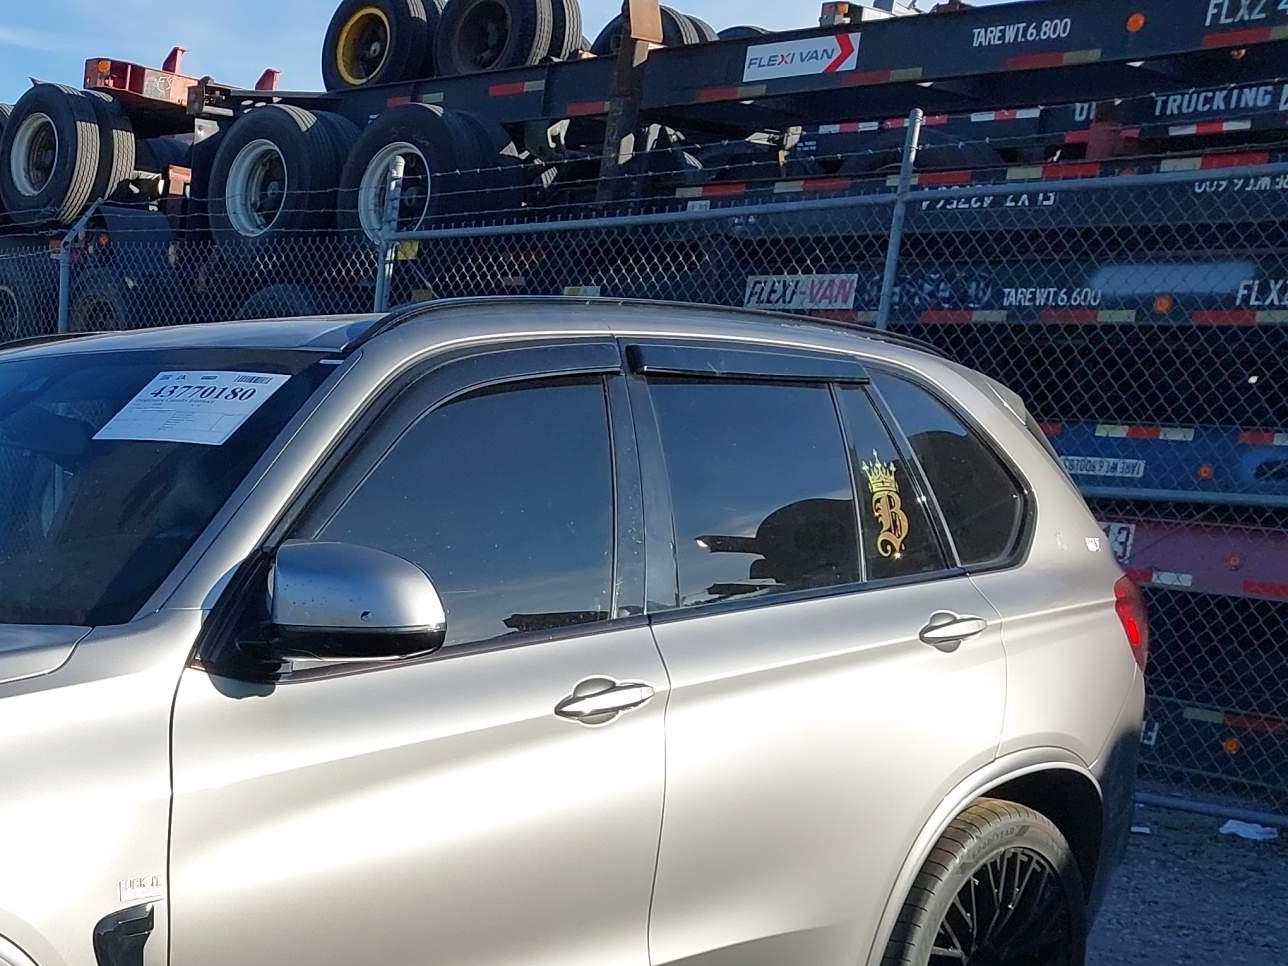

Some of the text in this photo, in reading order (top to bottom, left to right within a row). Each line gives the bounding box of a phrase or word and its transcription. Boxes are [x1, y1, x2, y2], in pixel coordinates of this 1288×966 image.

[747, 48, 835, 69] FLEXI VAN
[1154, 85, 1273, 116] TRUCKING
[747, 278, 854, 305] FLEXI-VAN
[150, 385, 256, 400] 43770180
